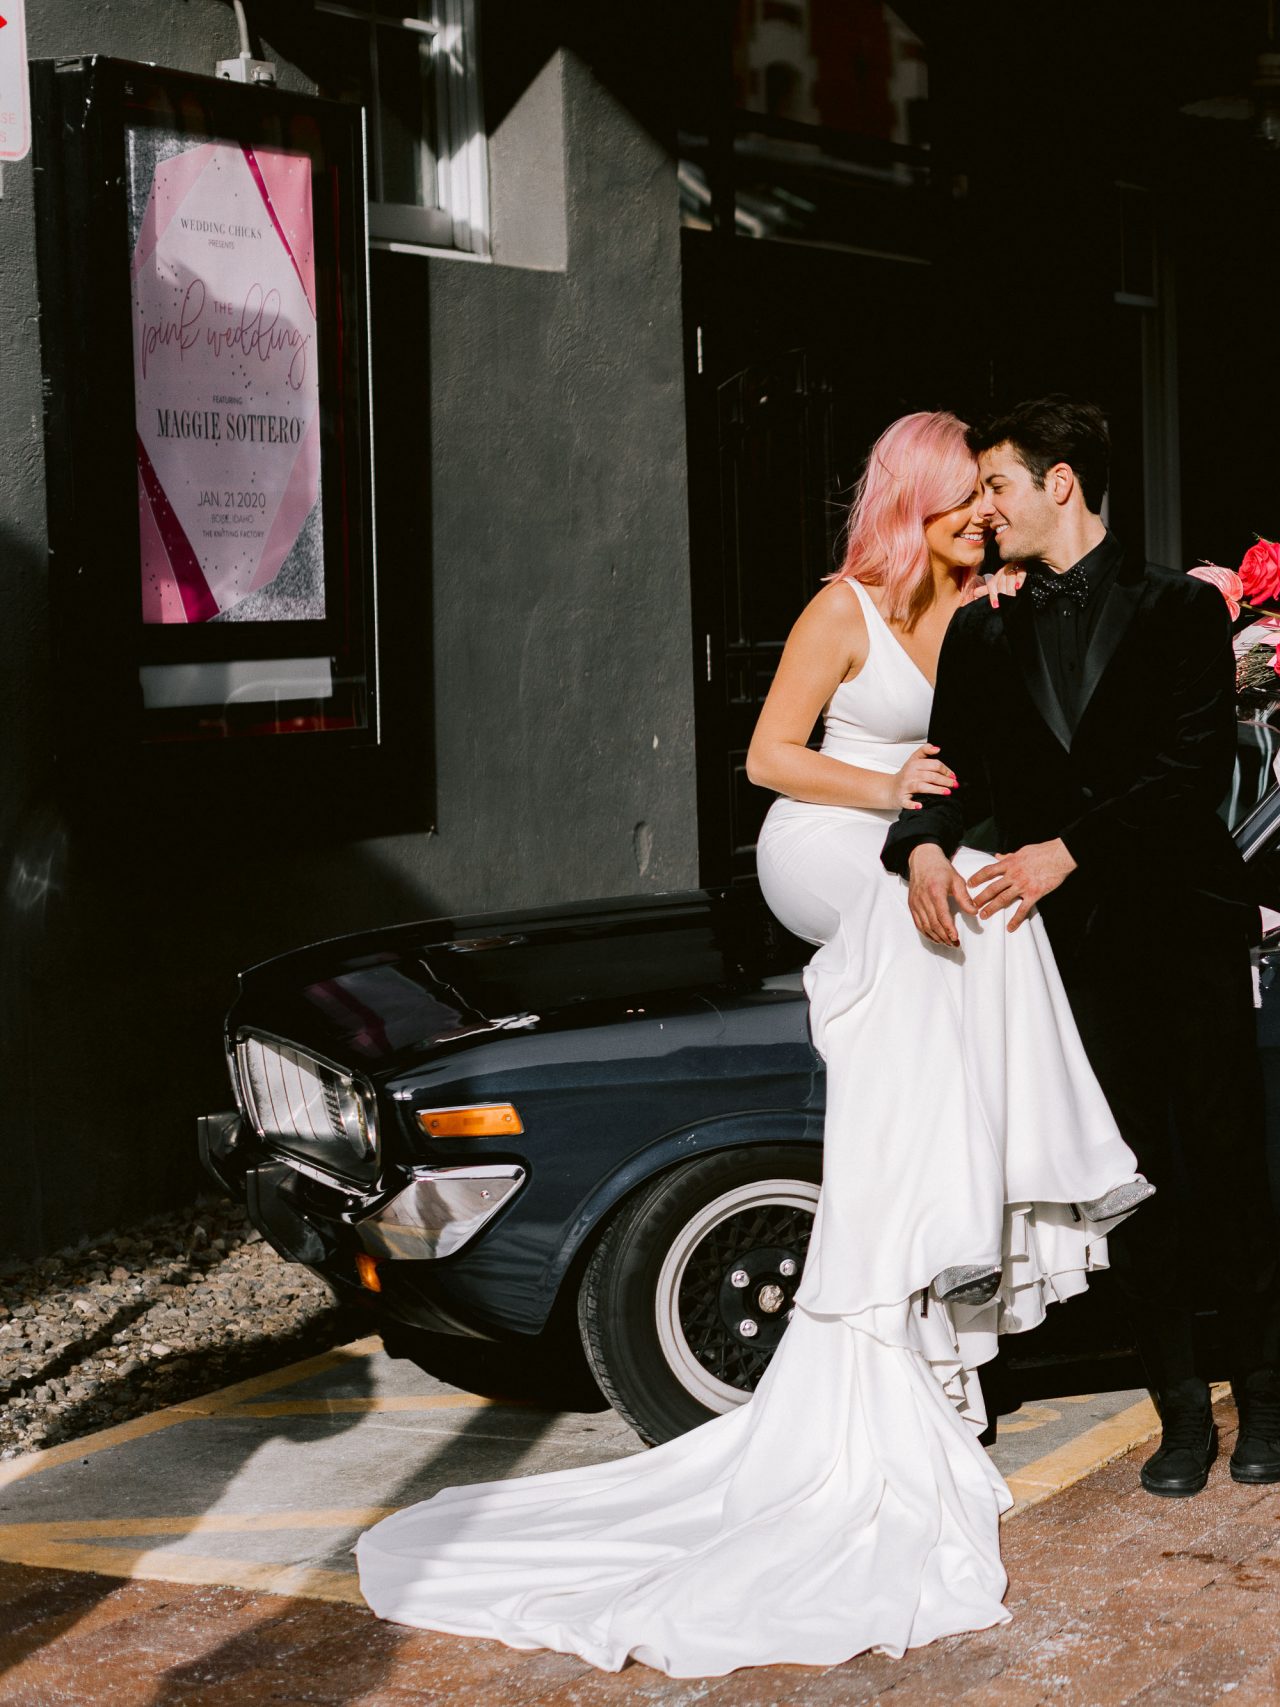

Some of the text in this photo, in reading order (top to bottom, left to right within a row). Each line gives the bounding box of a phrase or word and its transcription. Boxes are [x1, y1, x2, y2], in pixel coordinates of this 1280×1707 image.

[180, 218, 262, 239] WEDDING CHICKS
[208, 239, 235, 250] PRESENTS
[214, 301, 233, 315] THE
[141, 279, 309, 390] pink wedding
[212, 395, 243, 405] FEATURING
[156, 408, 301, 444] MAGGIE SOTTERO
[197, 491, 266, 508] JAN. 21 2020
[202, 530, 213, 538] THE
[240, 530, 265, 538] FACTORY
